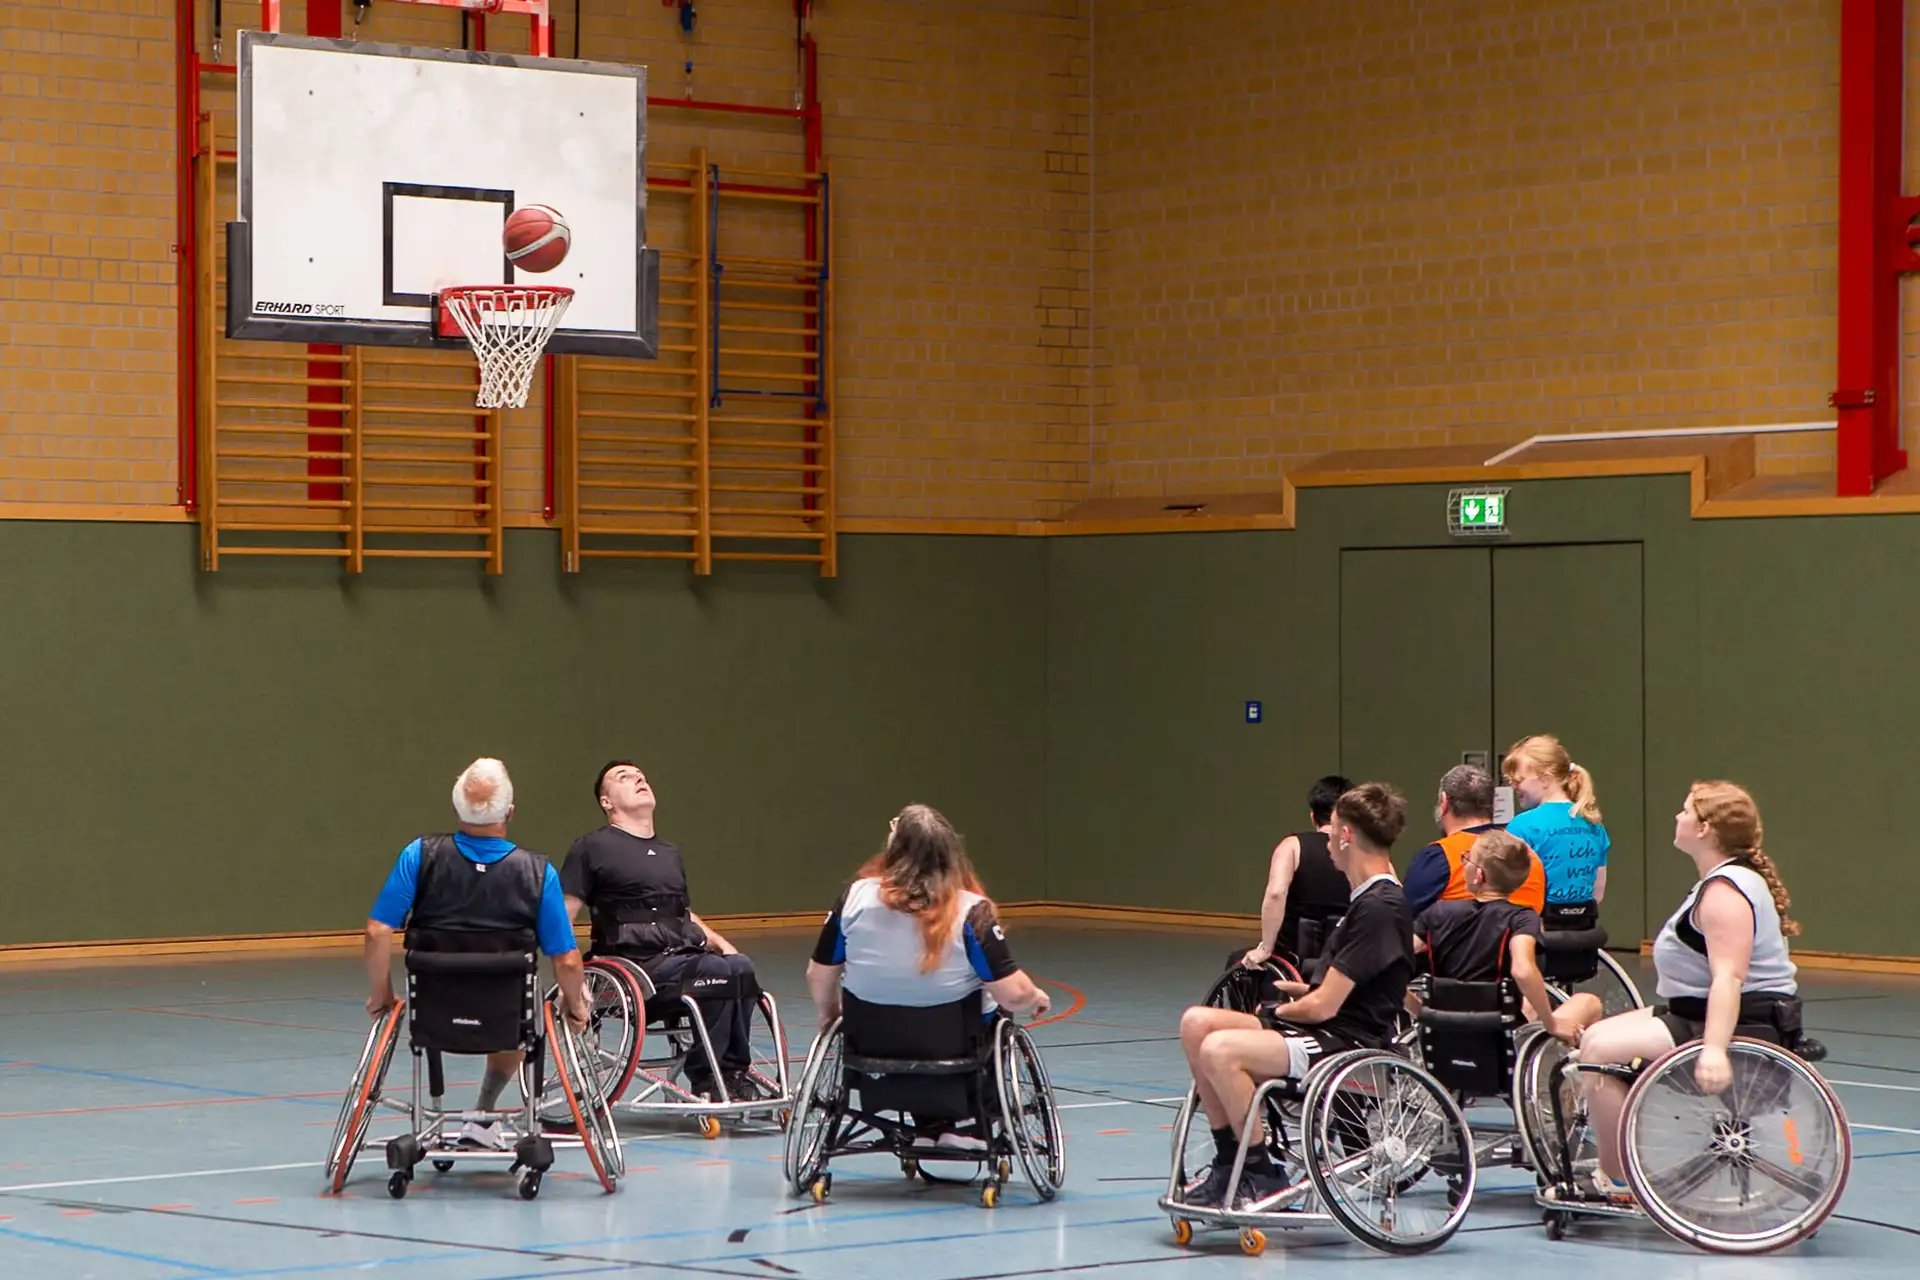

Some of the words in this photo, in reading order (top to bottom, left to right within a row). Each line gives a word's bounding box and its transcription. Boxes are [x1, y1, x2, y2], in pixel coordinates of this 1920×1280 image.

[255, 301, 312, 314] ERHARD
[315, 304, 345, 315] SPORT
[1568, 840, 1597, 859] ich
